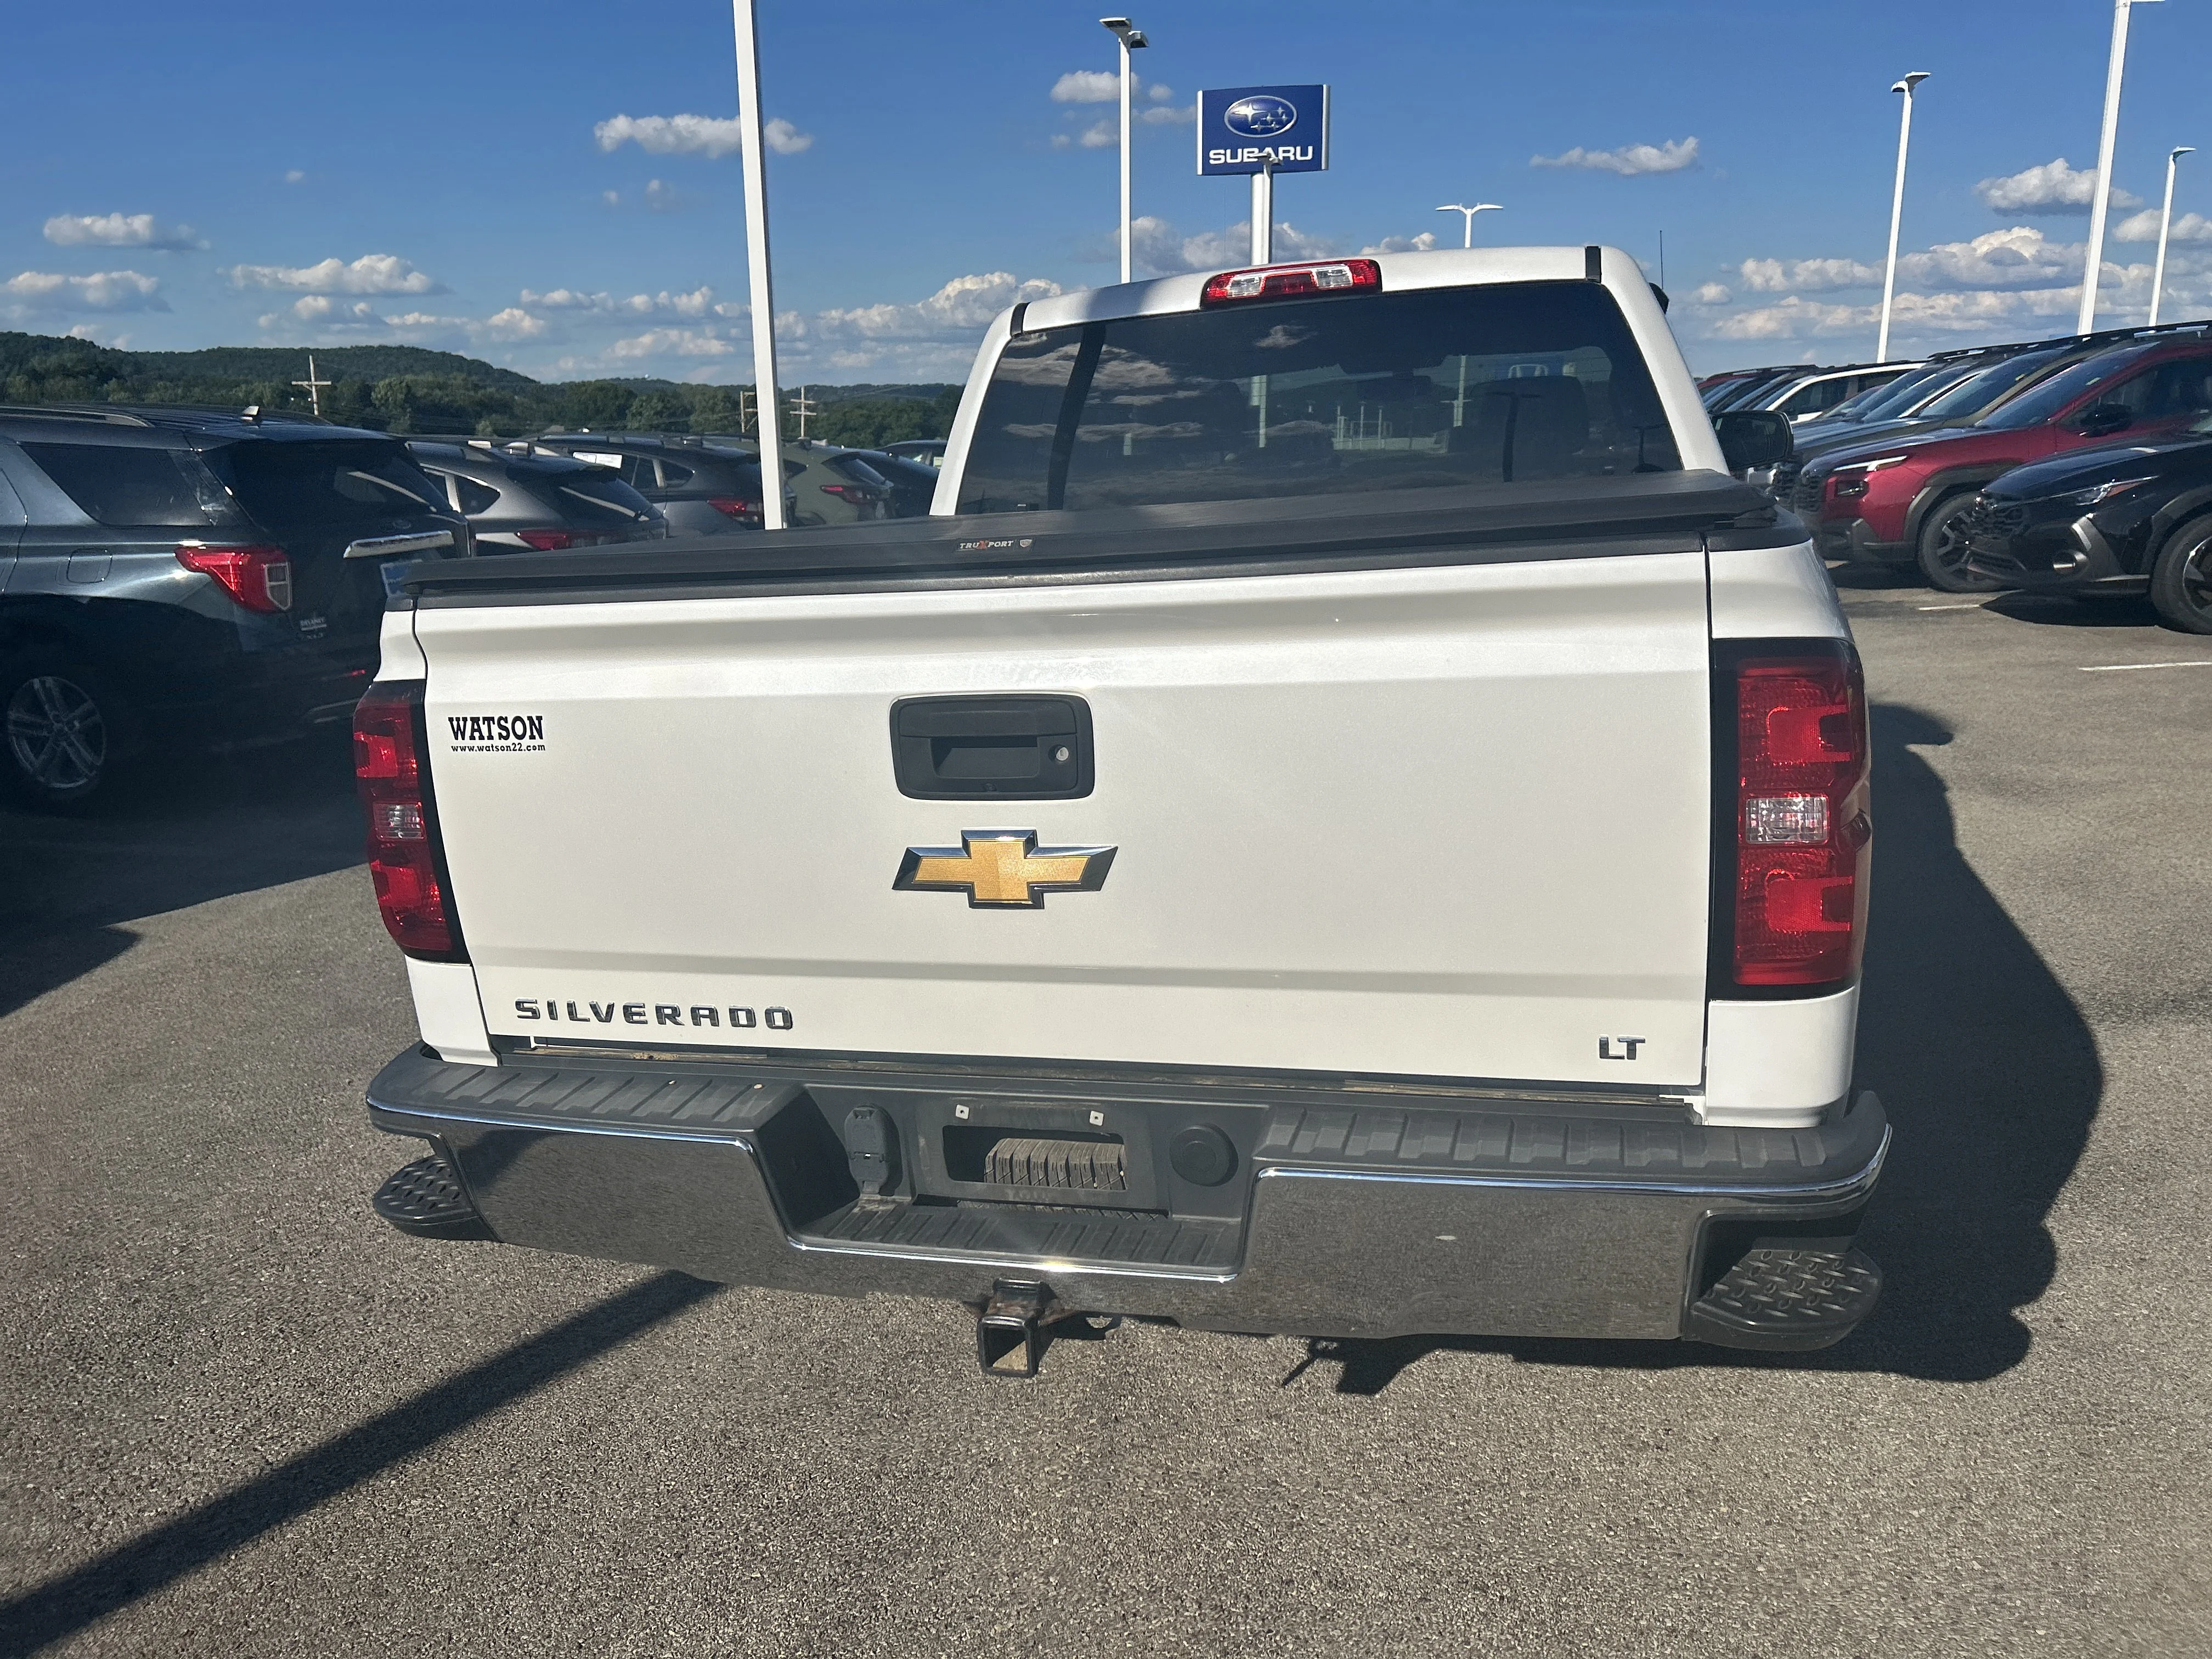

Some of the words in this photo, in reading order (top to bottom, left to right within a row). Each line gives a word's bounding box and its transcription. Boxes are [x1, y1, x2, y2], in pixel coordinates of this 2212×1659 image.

[1209, 145, 1313, 165] SUBARU
[960, 540, 1013, 550] TRUXPORT
[448, 715, 544, 741] WATSON
[451, 742, 546, 752] www.watson22.com
[515, 997, 793, 1030] SILVERADO
[1599, 1035, 1645, 1060] LT
